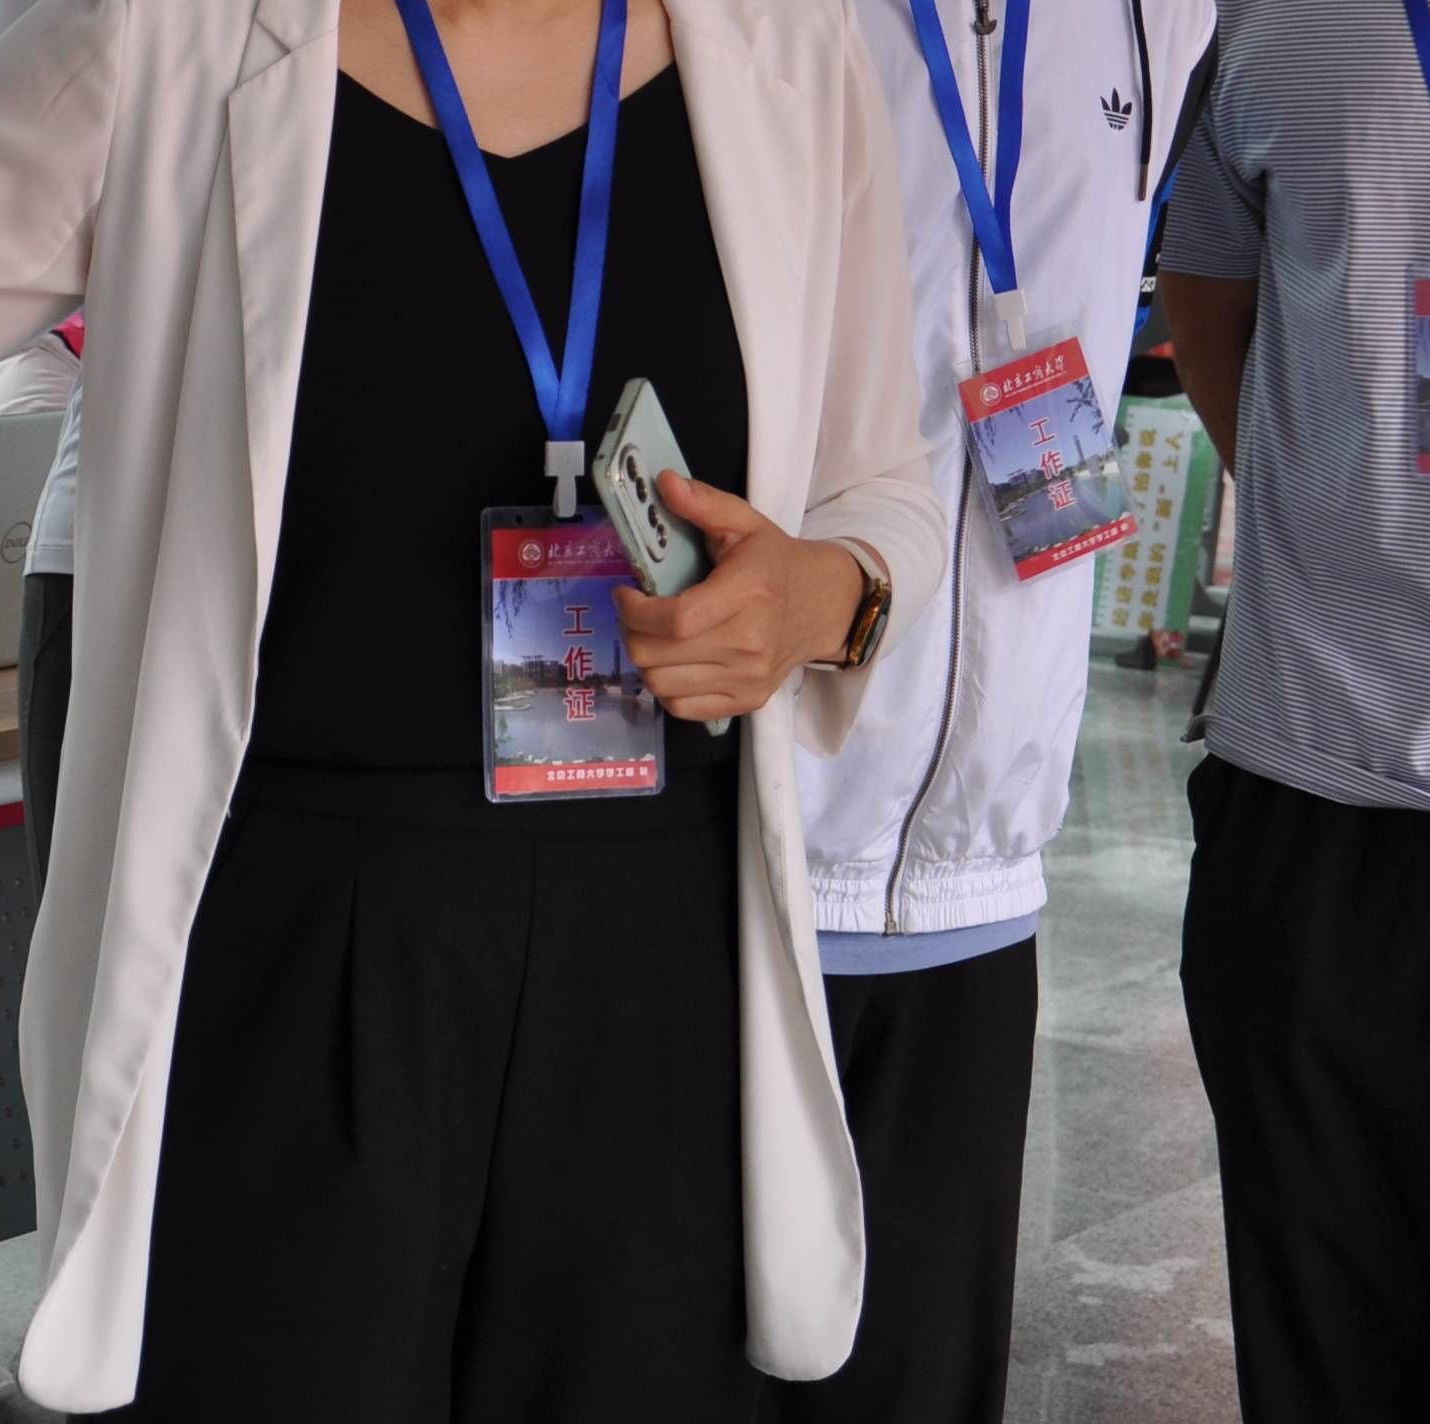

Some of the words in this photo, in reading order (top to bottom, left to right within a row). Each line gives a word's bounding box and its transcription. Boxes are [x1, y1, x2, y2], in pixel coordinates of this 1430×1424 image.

[1029, 417, 1078, 512] 工作证
[564, 605, 595, 721] 工作证
